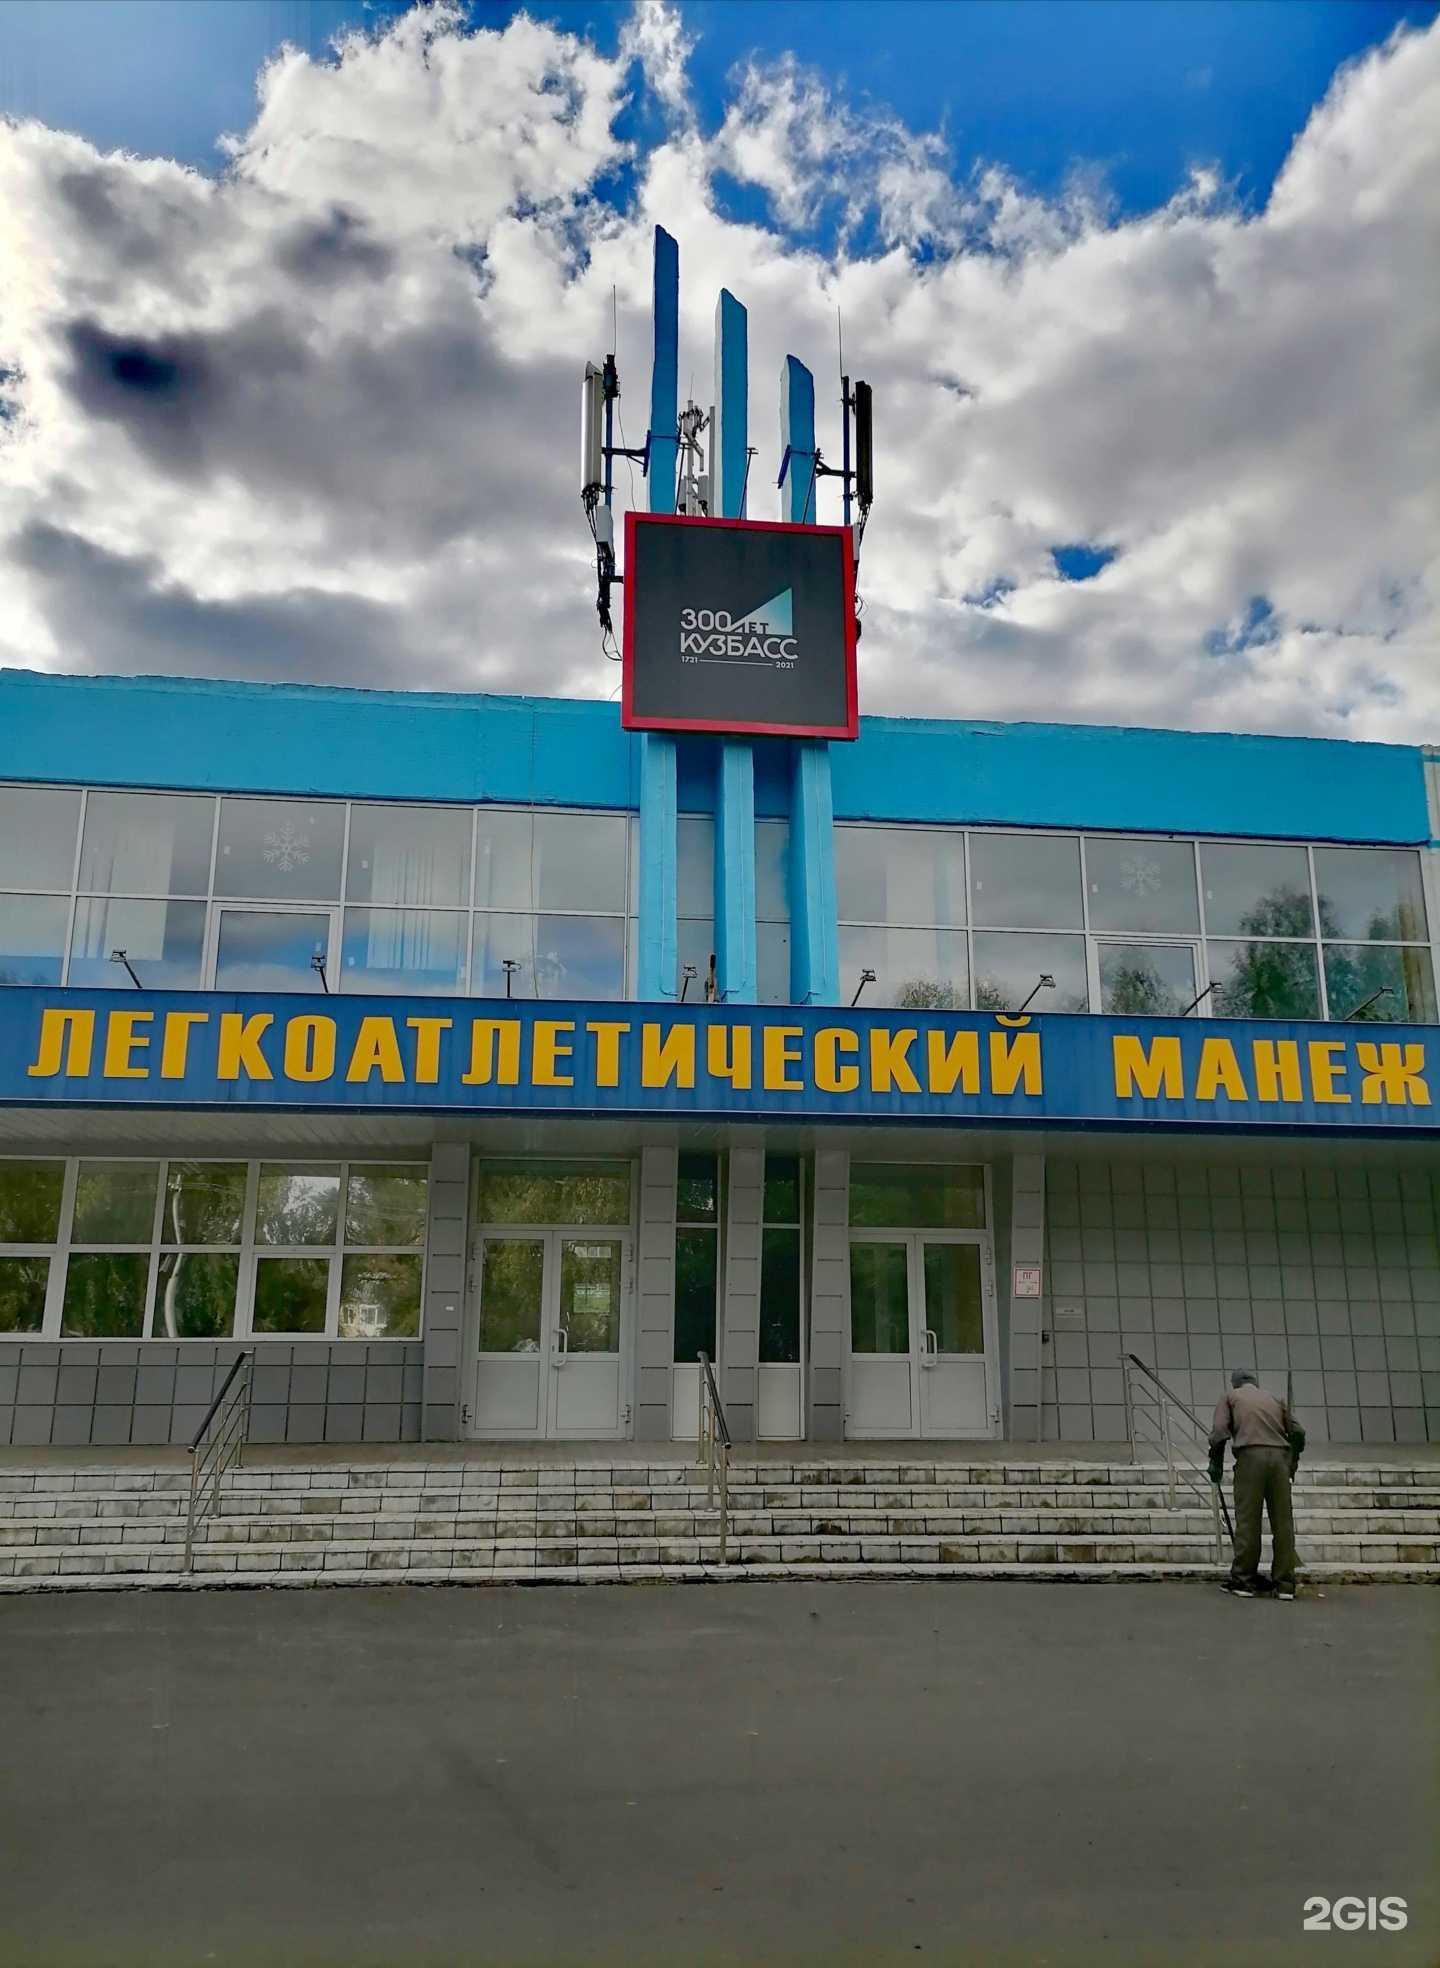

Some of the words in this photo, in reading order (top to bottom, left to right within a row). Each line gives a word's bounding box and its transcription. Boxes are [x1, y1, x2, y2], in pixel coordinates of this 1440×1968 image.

[680, 608, 732, 632] 300
[680, 632, 799, 660] КУЗБАСС
[775, 661, 794, 669] 2021
[27, 1008, 1044, 1097] ЛЕГКОАТЛЕТИЧЕСКИЙ
[1112, 1035, 1433, 1106] МАНЕЖ
